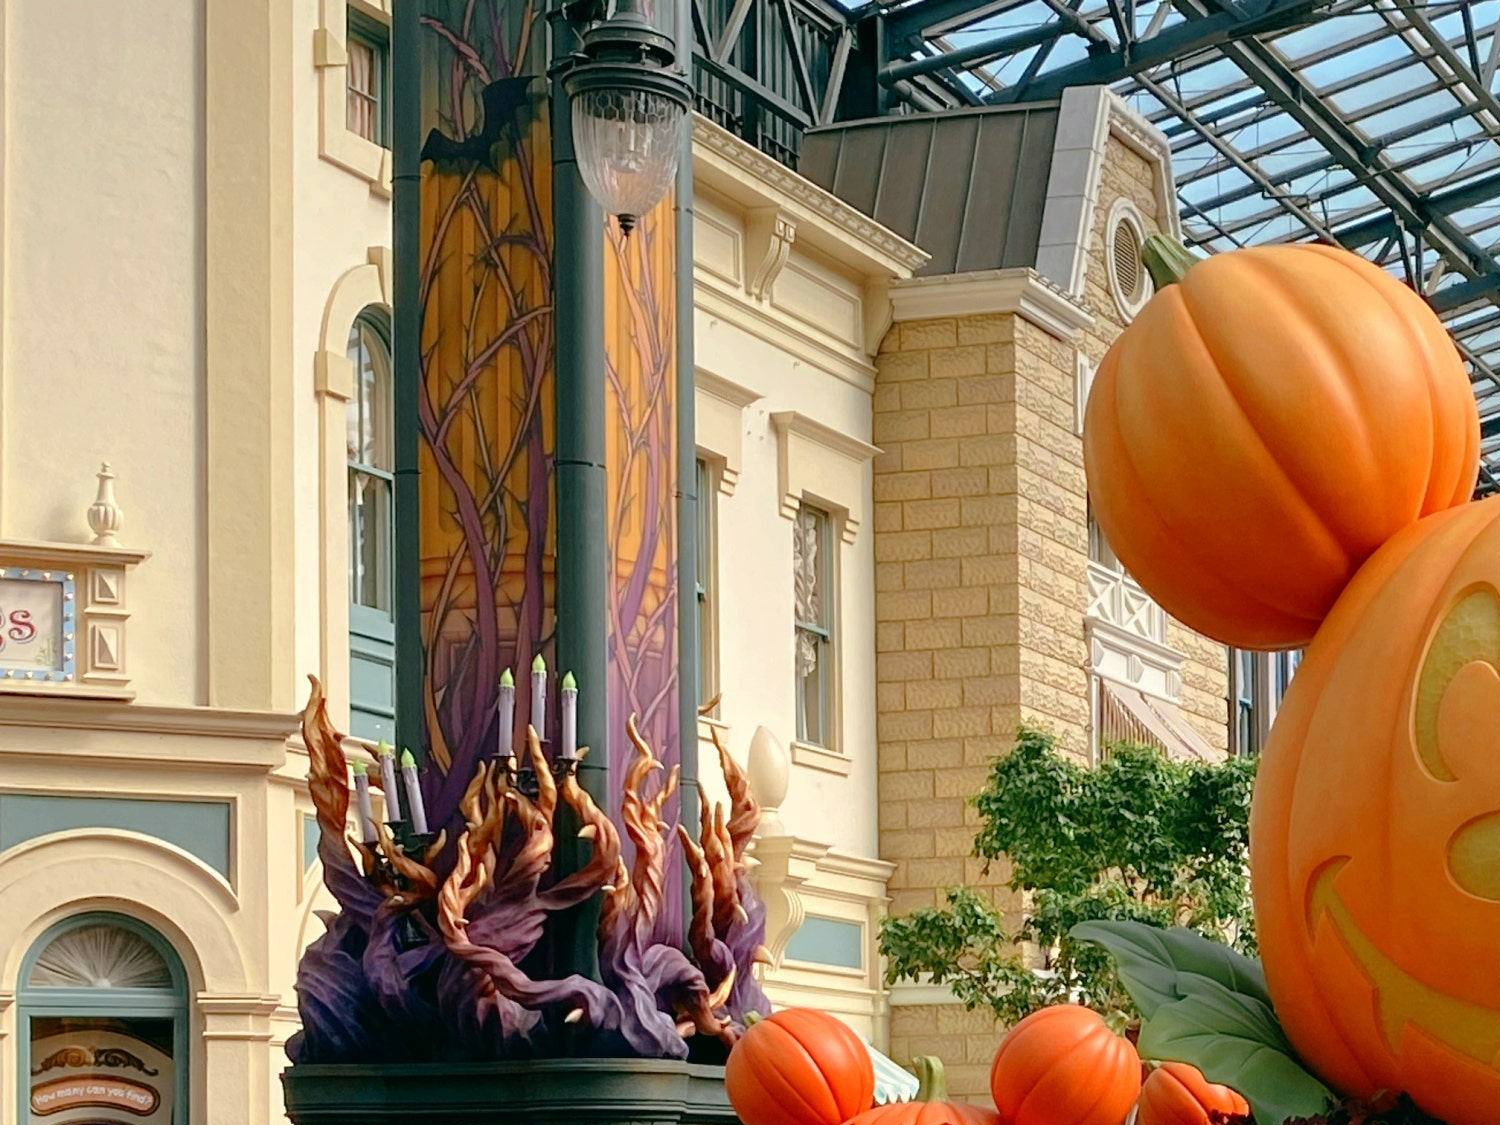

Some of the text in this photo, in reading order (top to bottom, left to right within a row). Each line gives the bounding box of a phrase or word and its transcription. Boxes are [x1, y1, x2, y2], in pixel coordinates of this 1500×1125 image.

[34, 1092, 56, 1105] How
[56, 1086, 85, 1098] many
[86, 1086, 106, 1094] can
[107, 1088, 125, 1097] you
